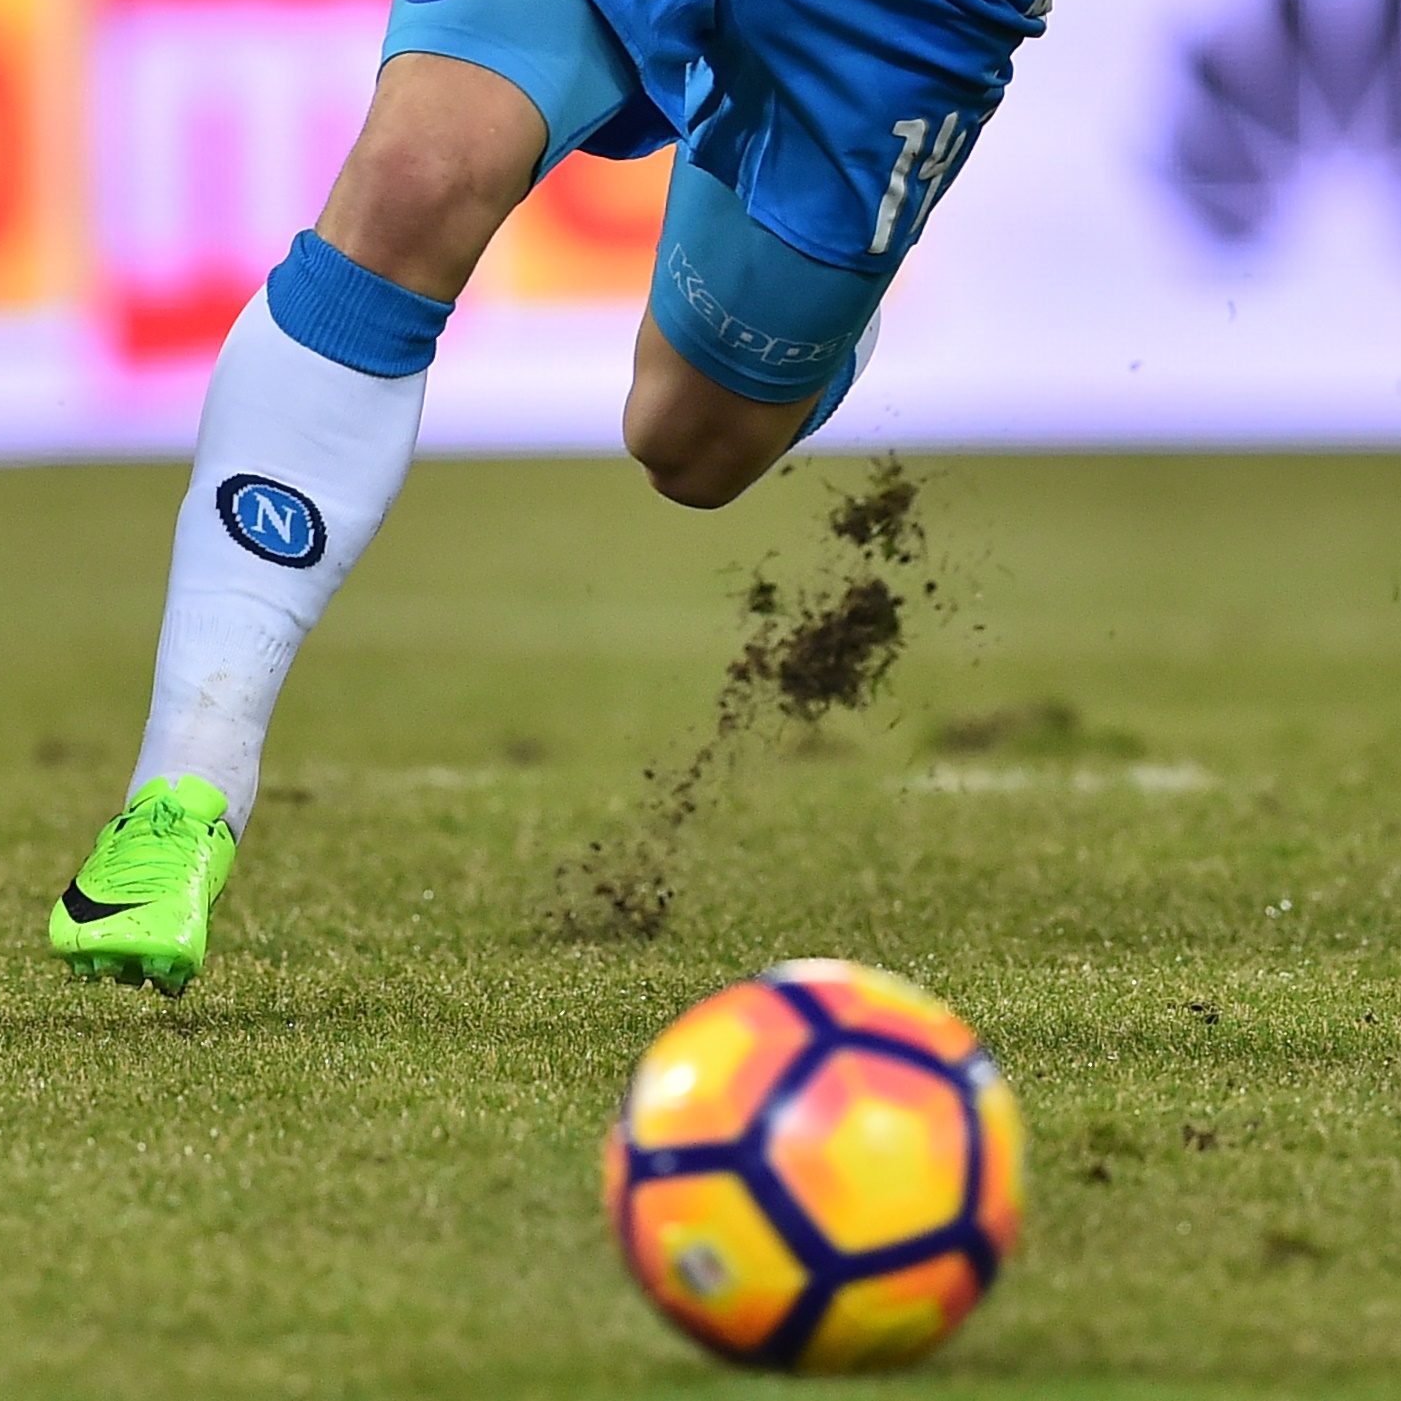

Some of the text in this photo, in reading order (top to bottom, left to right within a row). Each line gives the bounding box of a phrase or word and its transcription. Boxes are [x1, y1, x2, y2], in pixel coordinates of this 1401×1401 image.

[867, 111, 968, 255] 14
[667, 242, 852, 366] Kappa
[250, 491, 298, 544] N
